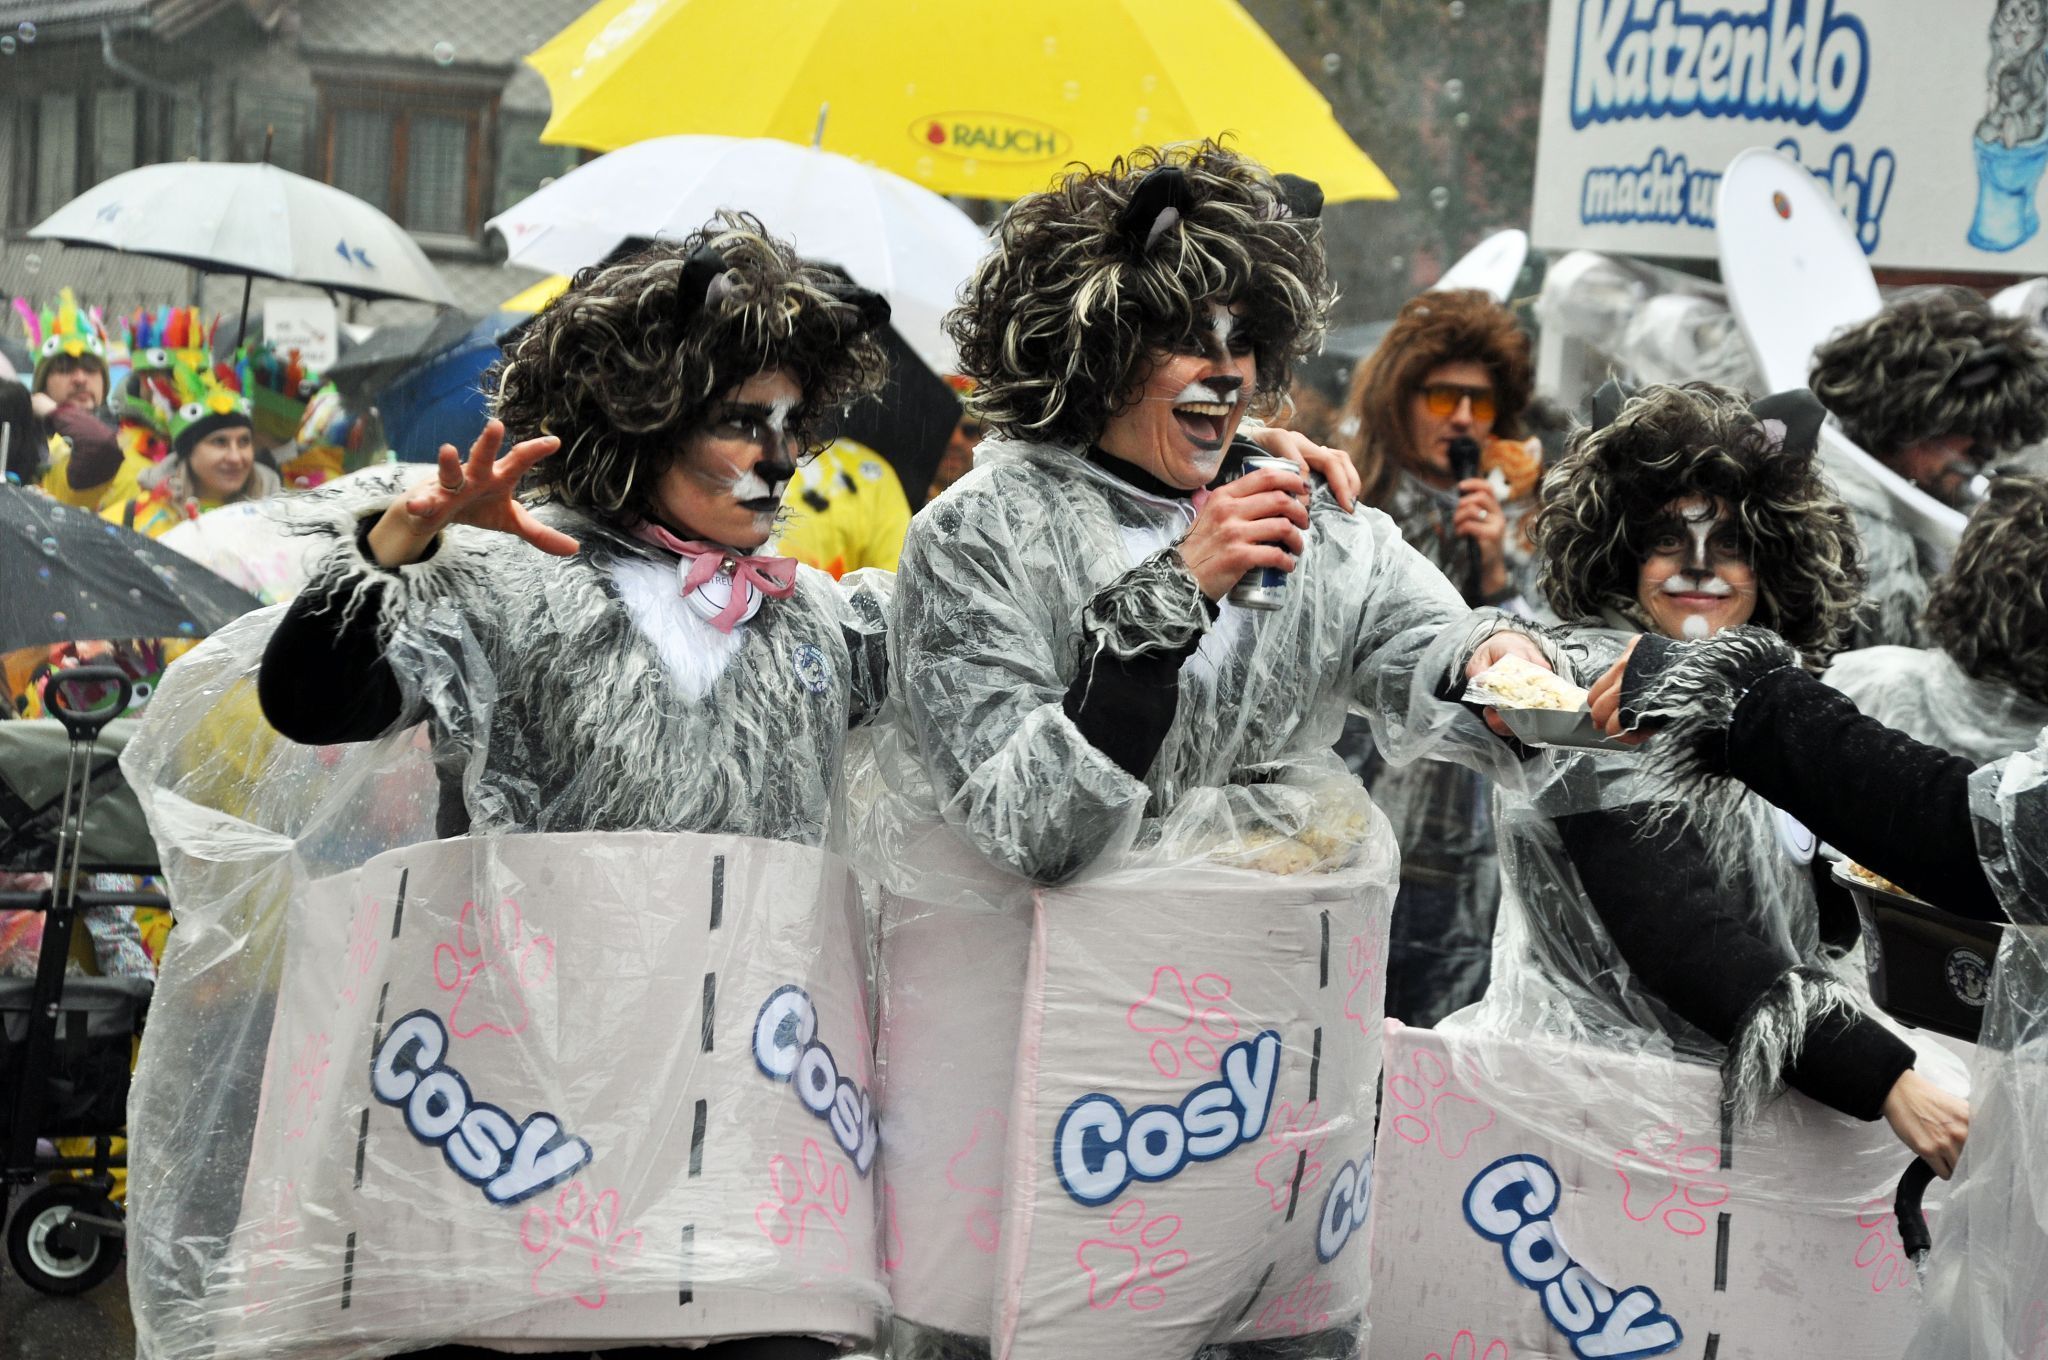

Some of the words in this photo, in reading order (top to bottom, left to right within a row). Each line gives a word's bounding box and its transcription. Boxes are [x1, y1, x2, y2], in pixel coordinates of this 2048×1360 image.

[953, 123, 1056, 154] RAUCH
[1571, 0, 1869, 131] Katzenklo
[1581, 146, 1687, 226] macht
[371, 1009, 593, 1207] Cosy
[752, 984, 879, 1179] Cosy
[1053, 1030, 1281, 1207] Cosy
[1462, 1154, 1683, 1360] Cosy
